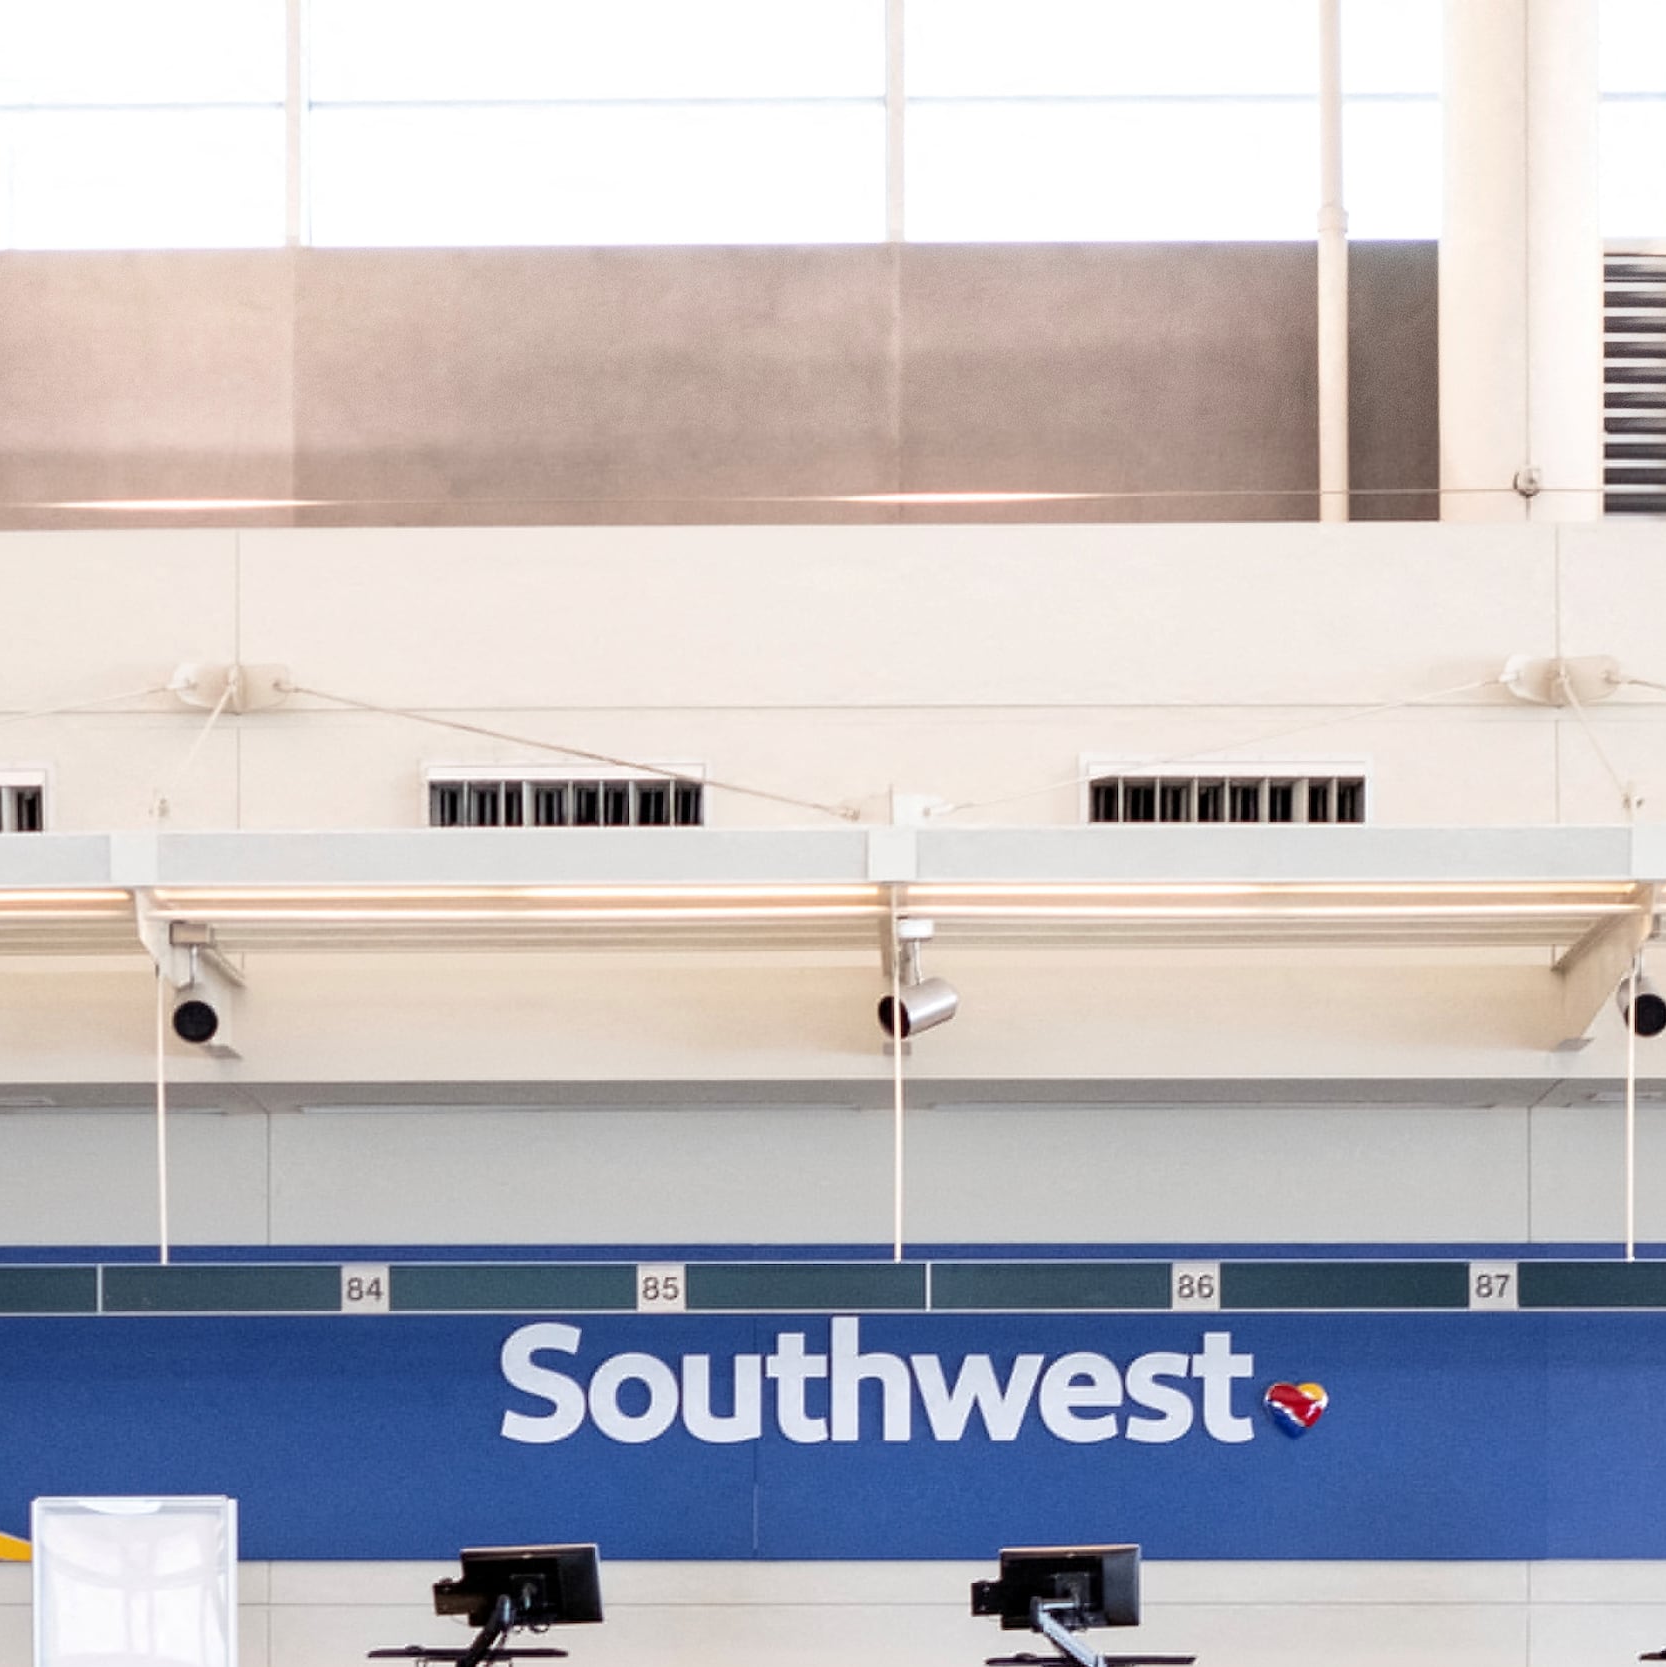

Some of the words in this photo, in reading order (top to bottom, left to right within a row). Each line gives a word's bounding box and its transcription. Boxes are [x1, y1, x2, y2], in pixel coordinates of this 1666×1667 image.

[346, 1277, 383, 1301] 84
[642, 1277, 679, 1301] 85
[1178, 1275, 1214, 1299] 86
[1475, 1274, 1510, 1299] 87
[500, 1317, 1254, 1444] Southwest
